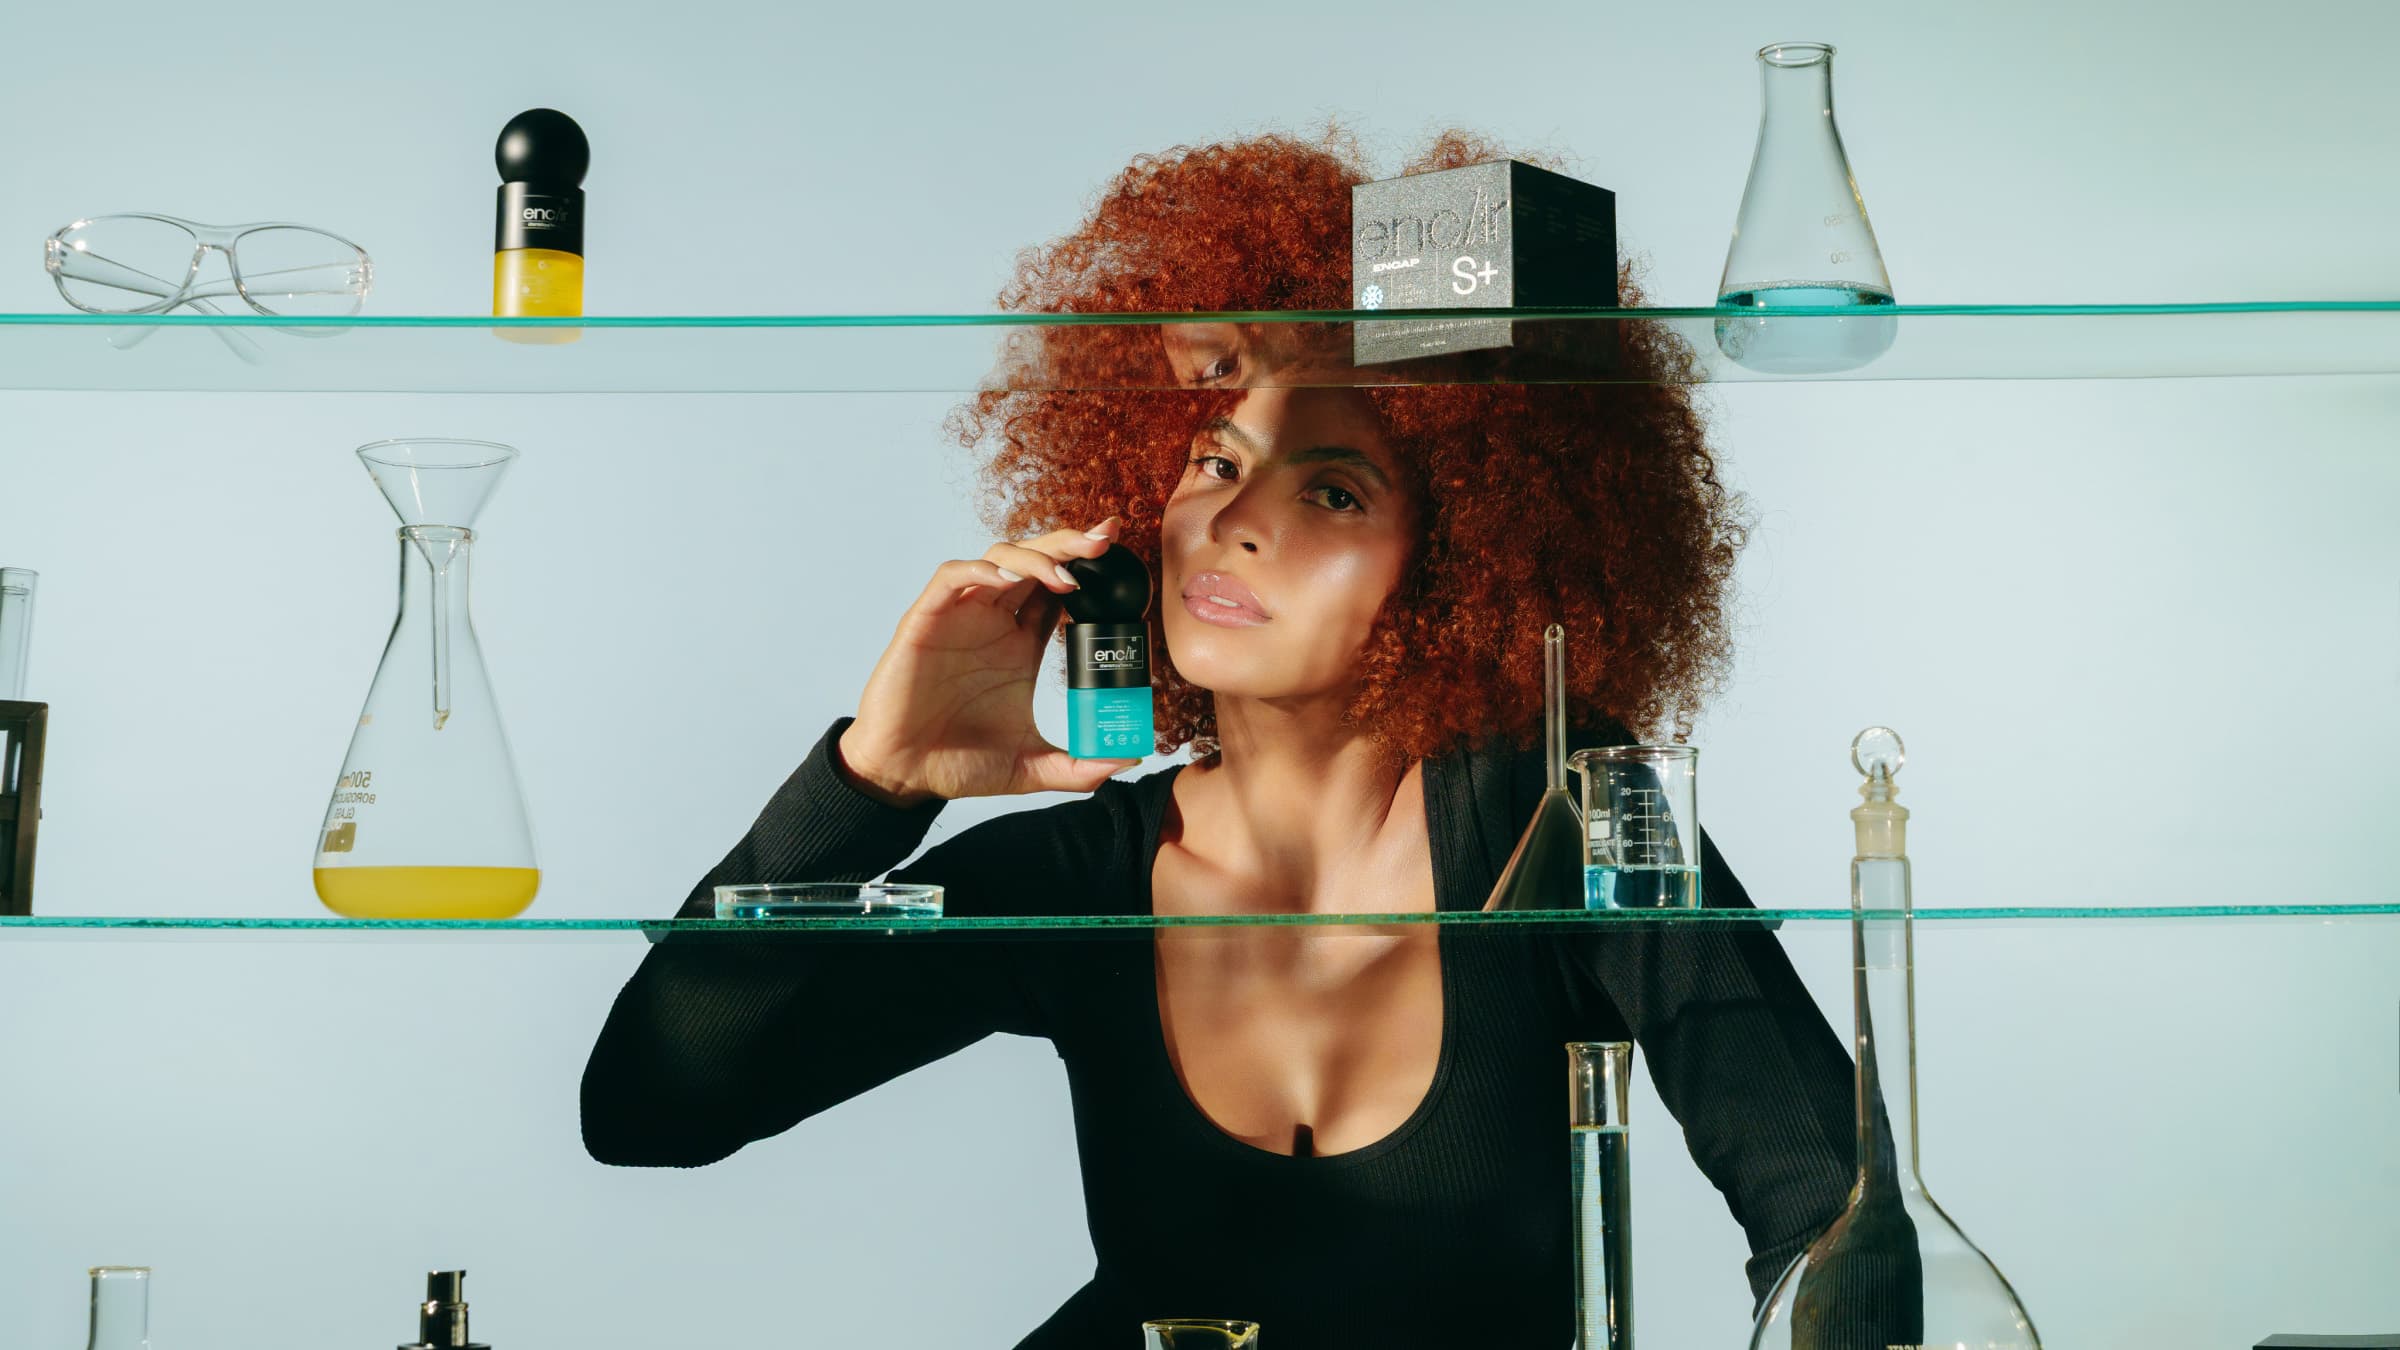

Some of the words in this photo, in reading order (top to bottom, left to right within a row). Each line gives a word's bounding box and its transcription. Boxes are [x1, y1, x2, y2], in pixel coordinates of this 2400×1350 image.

[1452, 255, 1498, 295] S+
[1620, 787, 1632, 796] 20
[1621, 812, 1633, 822] 40
[1664, 837, 1677, 849] 40
